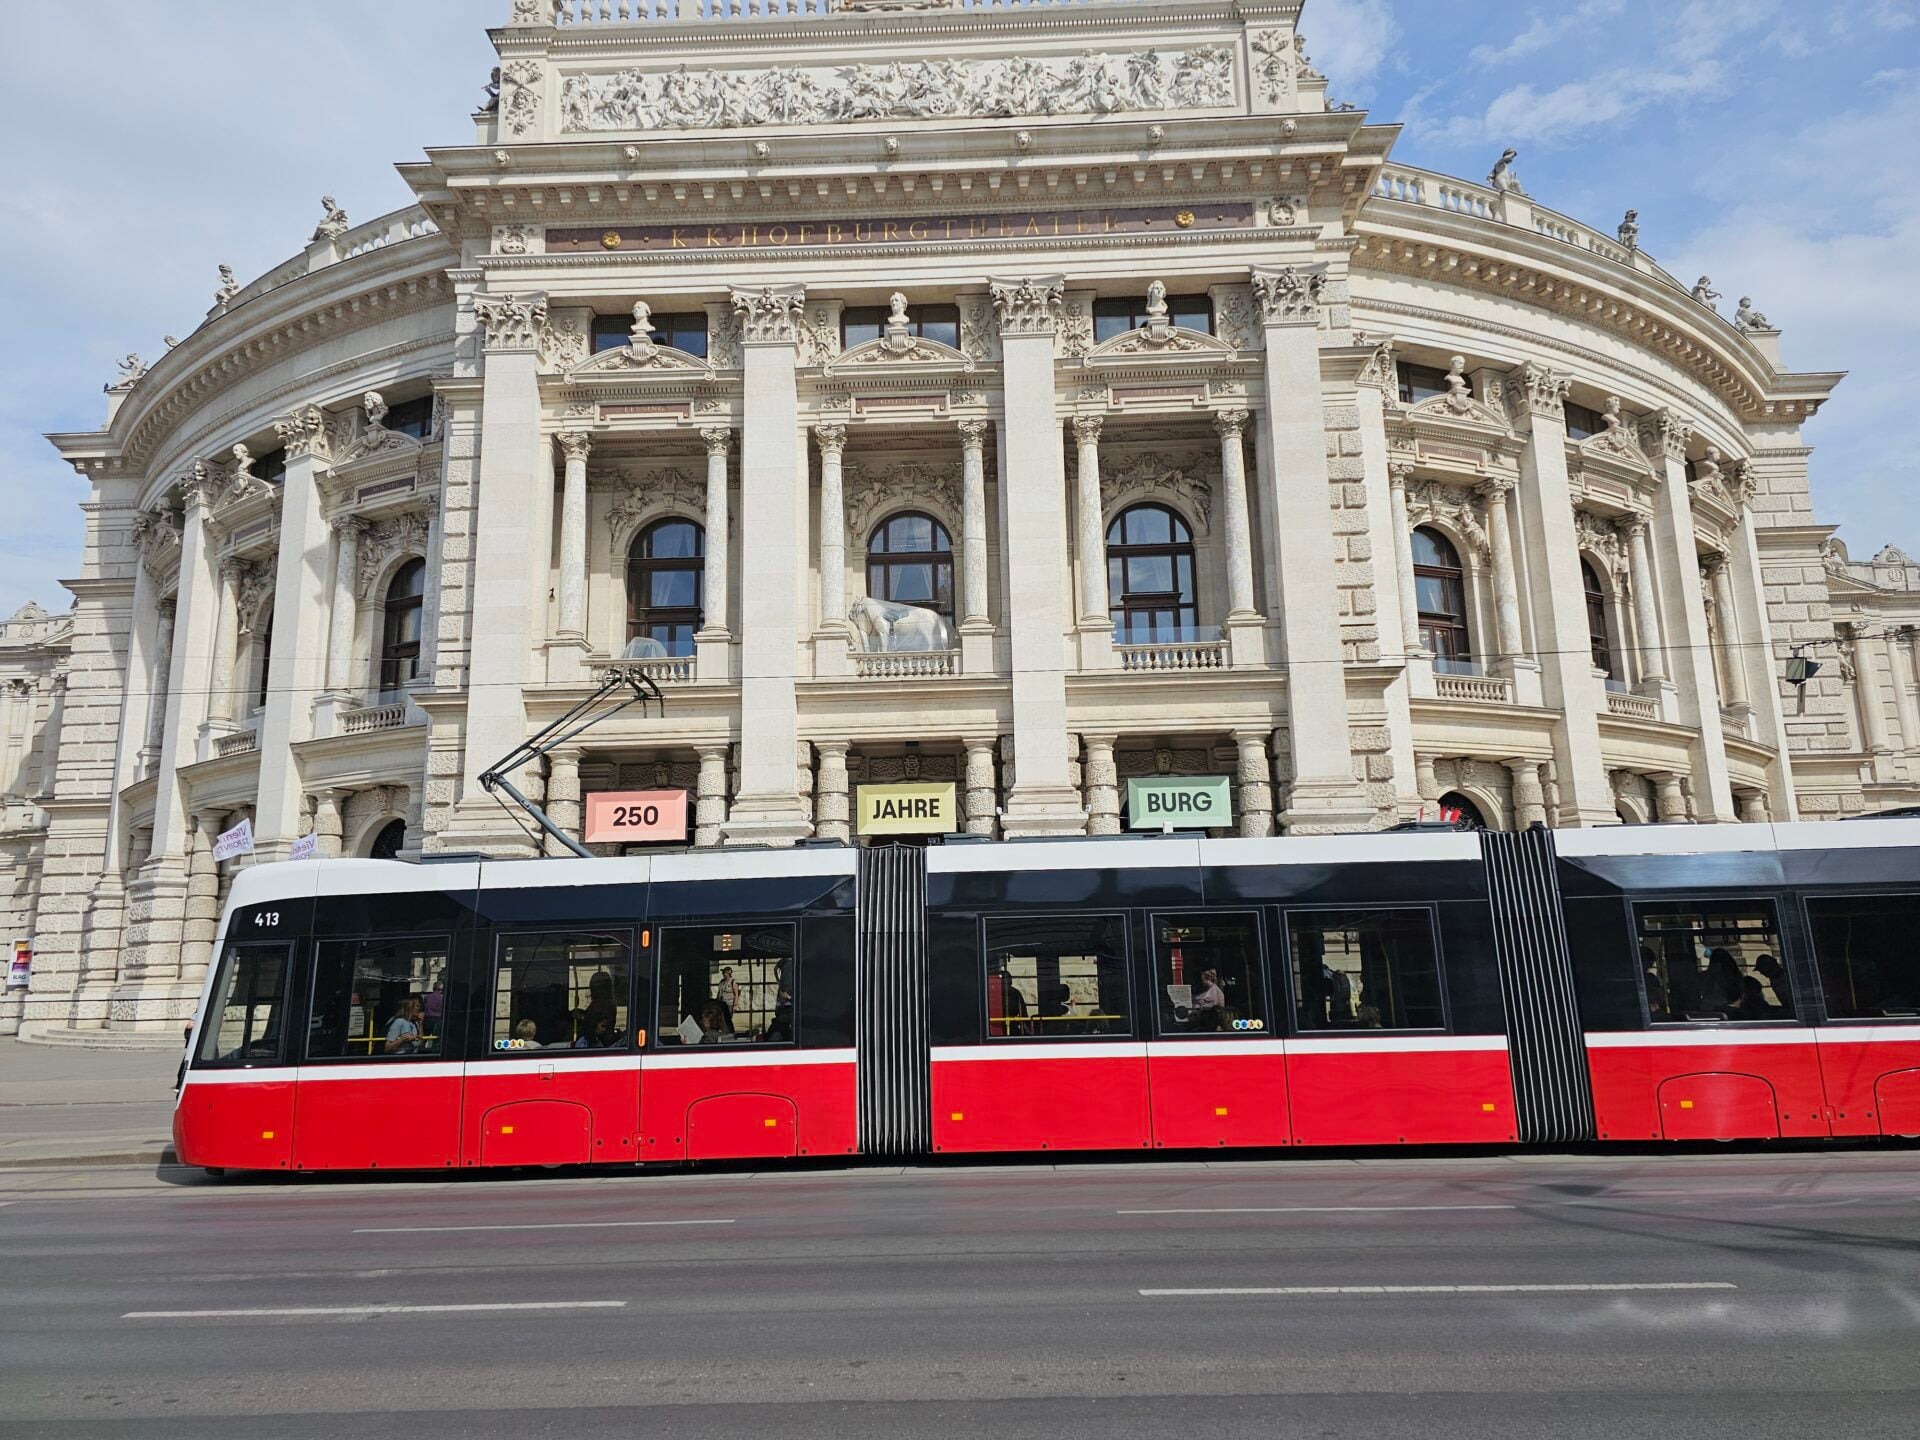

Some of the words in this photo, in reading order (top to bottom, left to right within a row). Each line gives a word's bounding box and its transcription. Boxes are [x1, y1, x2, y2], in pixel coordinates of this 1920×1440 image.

[872, 798, 940, 819] JAHRE
[1147, 791, 1212, 812] BURG
[613, 805, 659, 827] 250
[254, 912, 280, 927] 413
